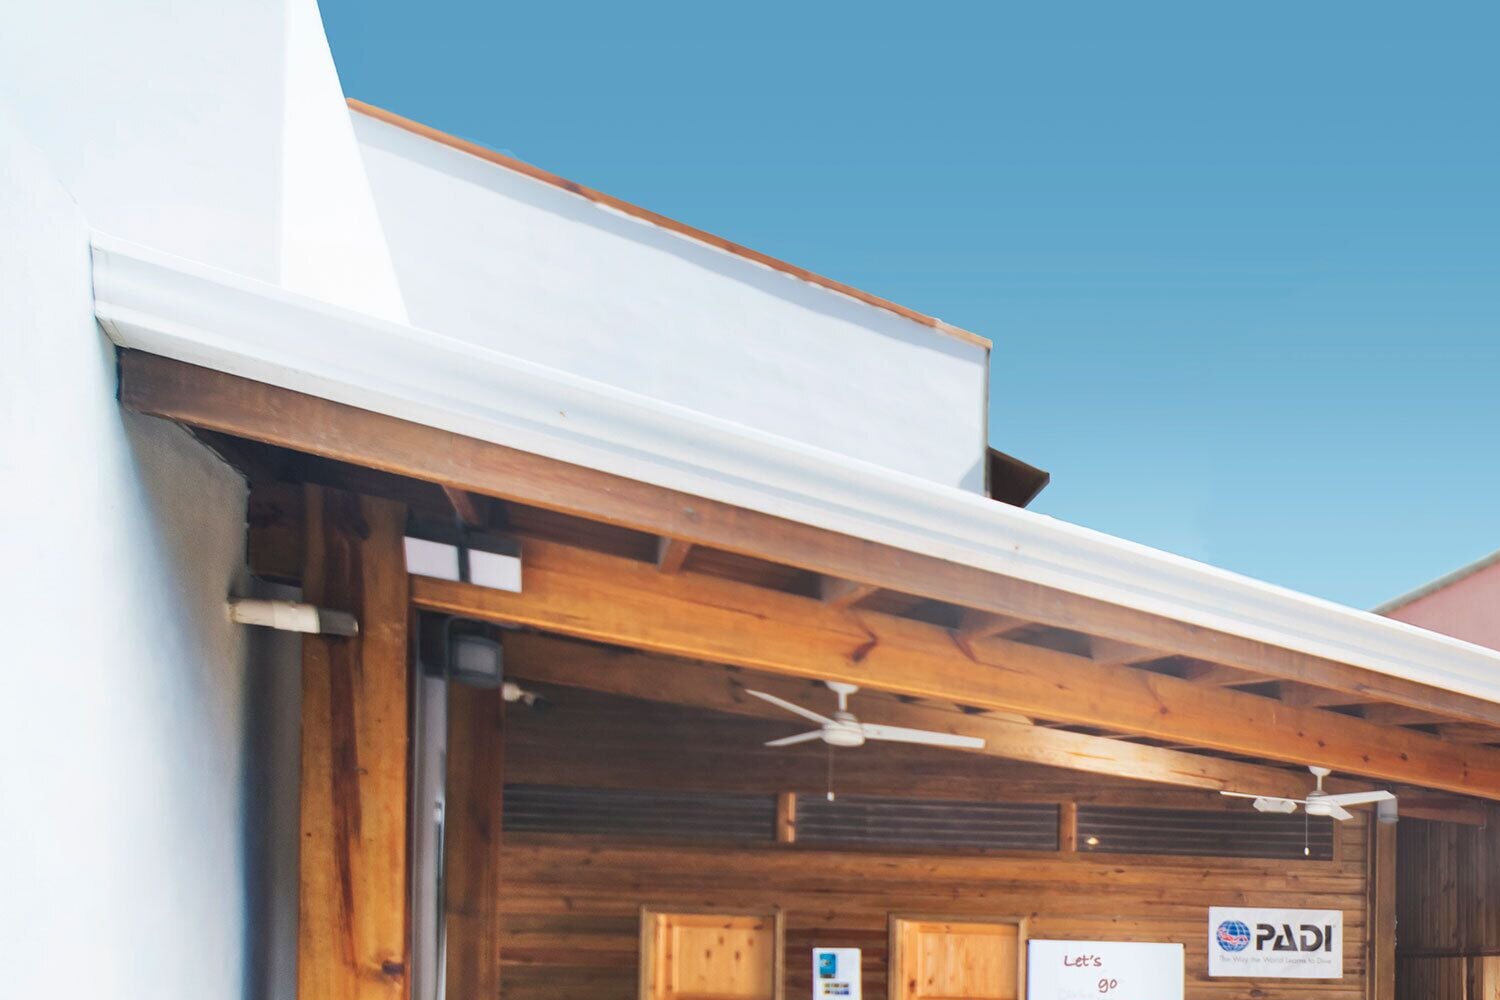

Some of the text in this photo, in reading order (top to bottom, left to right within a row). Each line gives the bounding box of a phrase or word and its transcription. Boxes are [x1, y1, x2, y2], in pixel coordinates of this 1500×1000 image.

[1256, 923, 1332, 952] PADI
[1064, 955, 1102, 968] Let's
[1098, 978, 1118, 994] go
